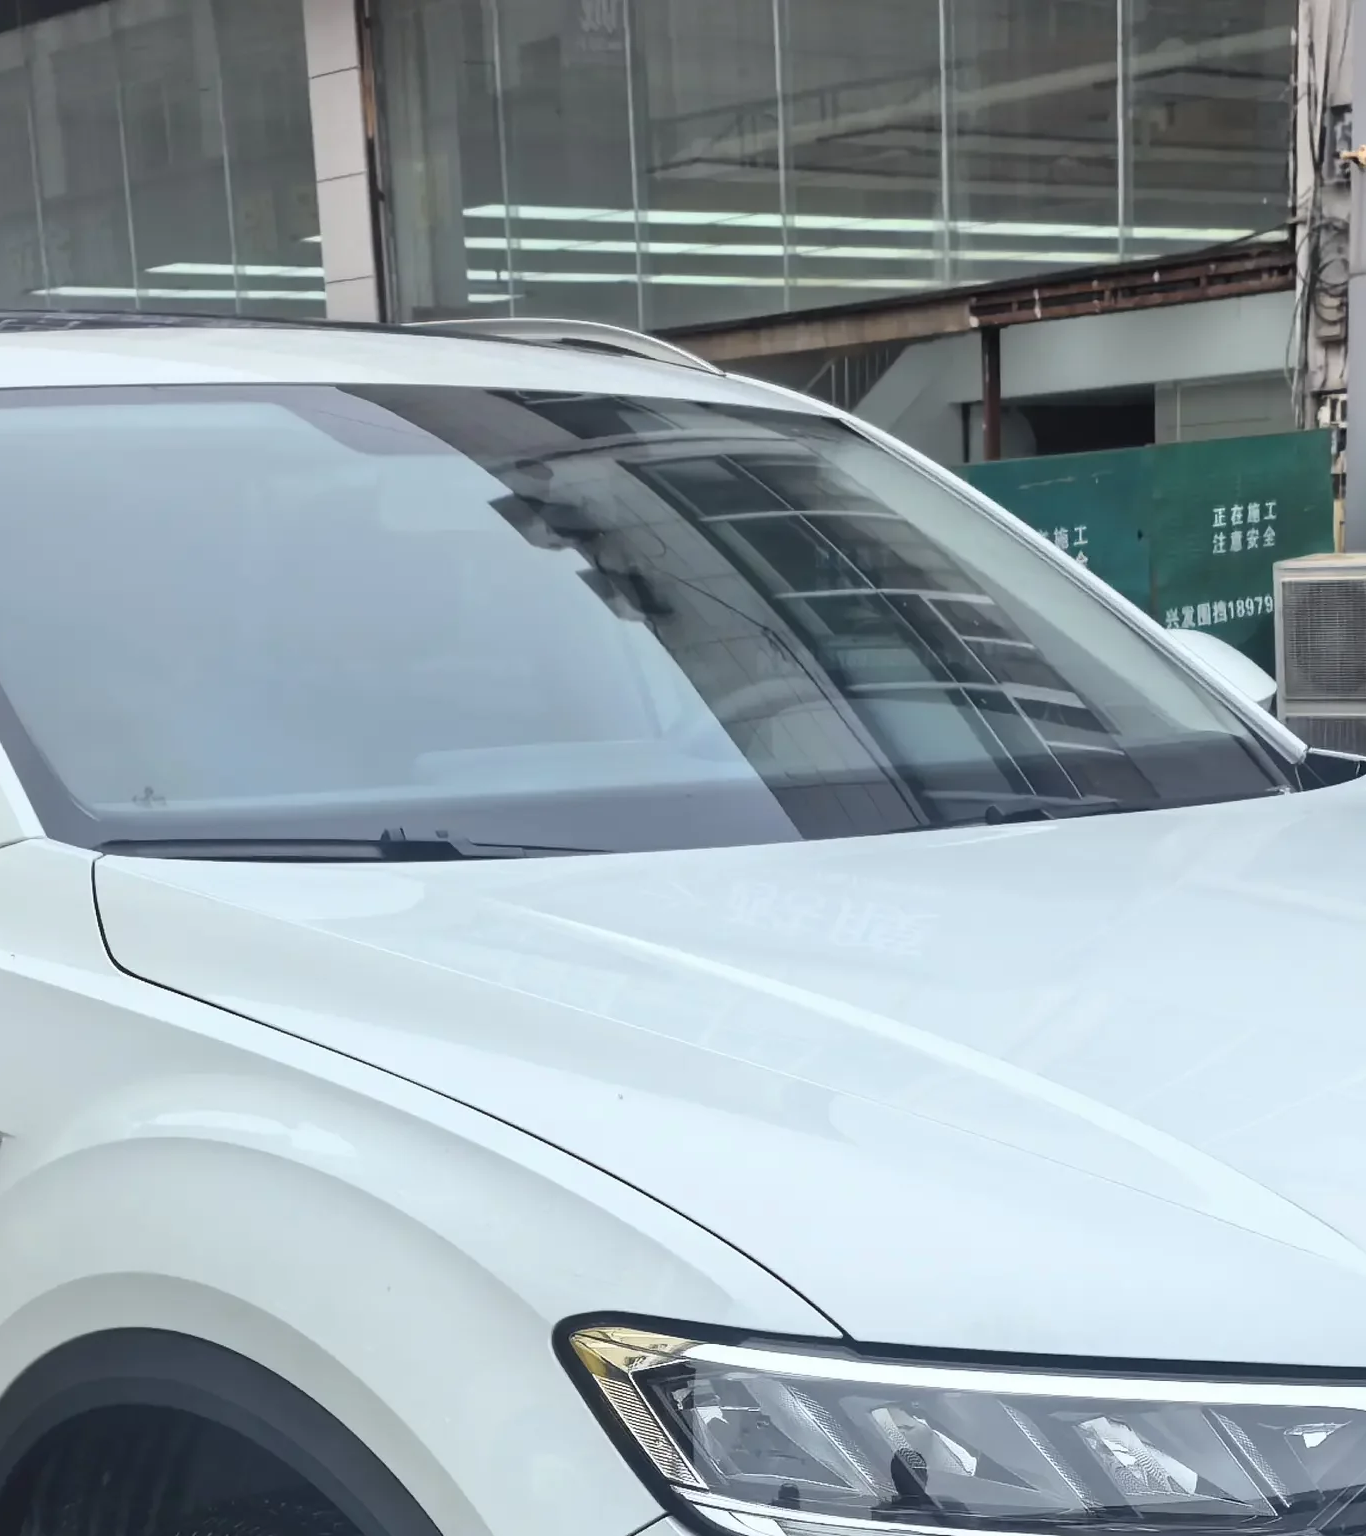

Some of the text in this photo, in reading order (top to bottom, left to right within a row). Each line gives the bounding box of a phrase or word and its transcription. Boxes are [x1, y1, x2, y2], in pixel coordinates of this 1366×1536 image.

[1212, 501, 1278, 528] 正在施工
[1212, 525, 1276, 555] 注意安全
